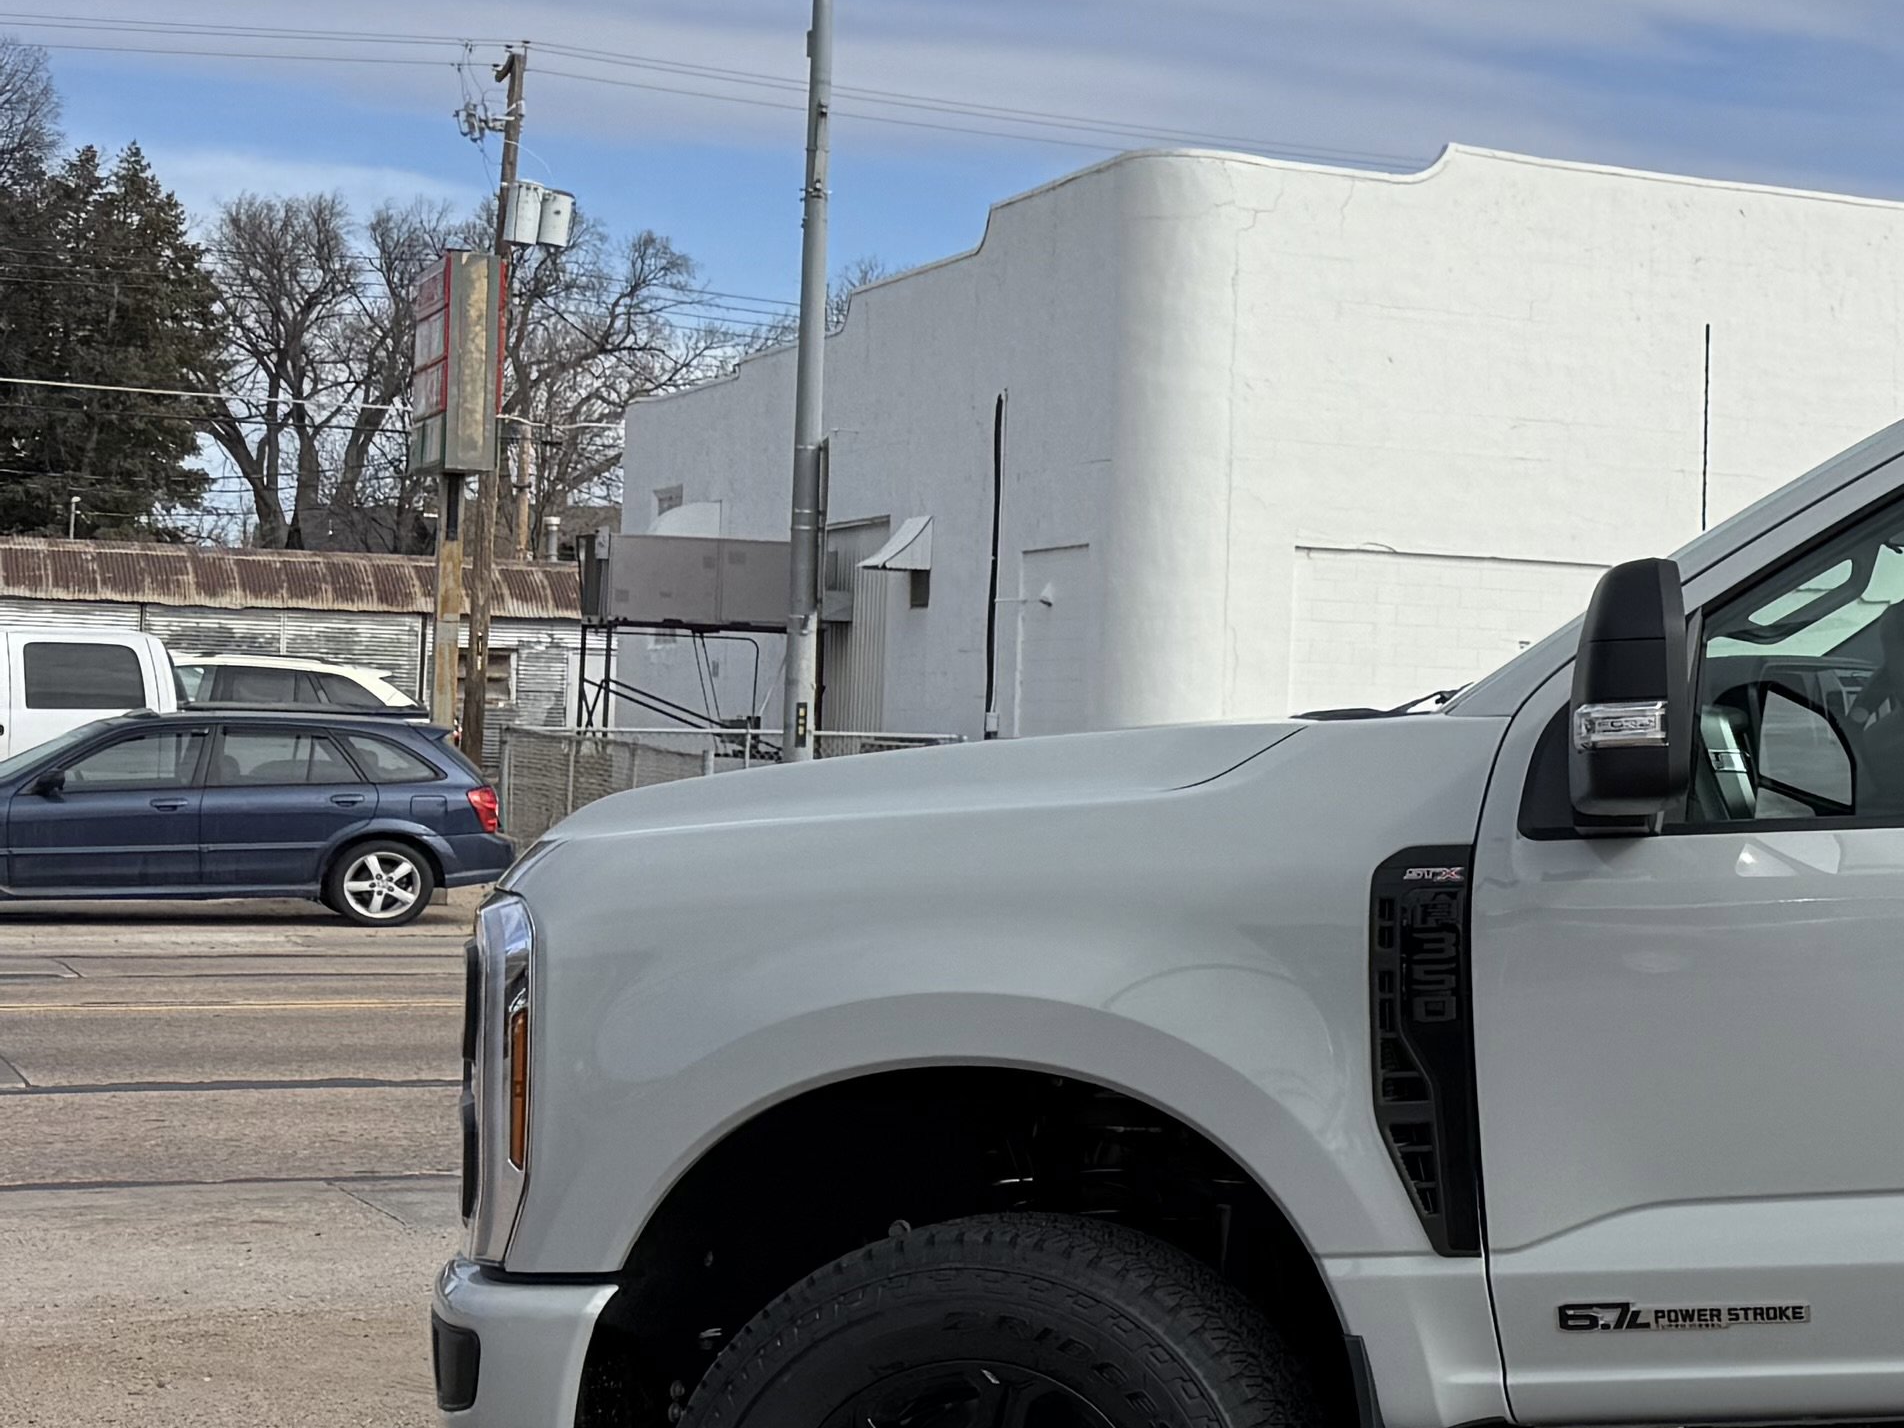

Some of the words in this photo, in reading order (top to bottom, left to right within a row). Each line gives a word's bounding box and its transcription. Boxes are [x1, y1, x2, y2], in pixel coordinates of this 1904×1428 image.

[1558, 1302, 1650, 1330] 6.7L
[1654, 1308, 1722, 1324] POWER
[1727, 1305, 1804, 1322] STROKE
